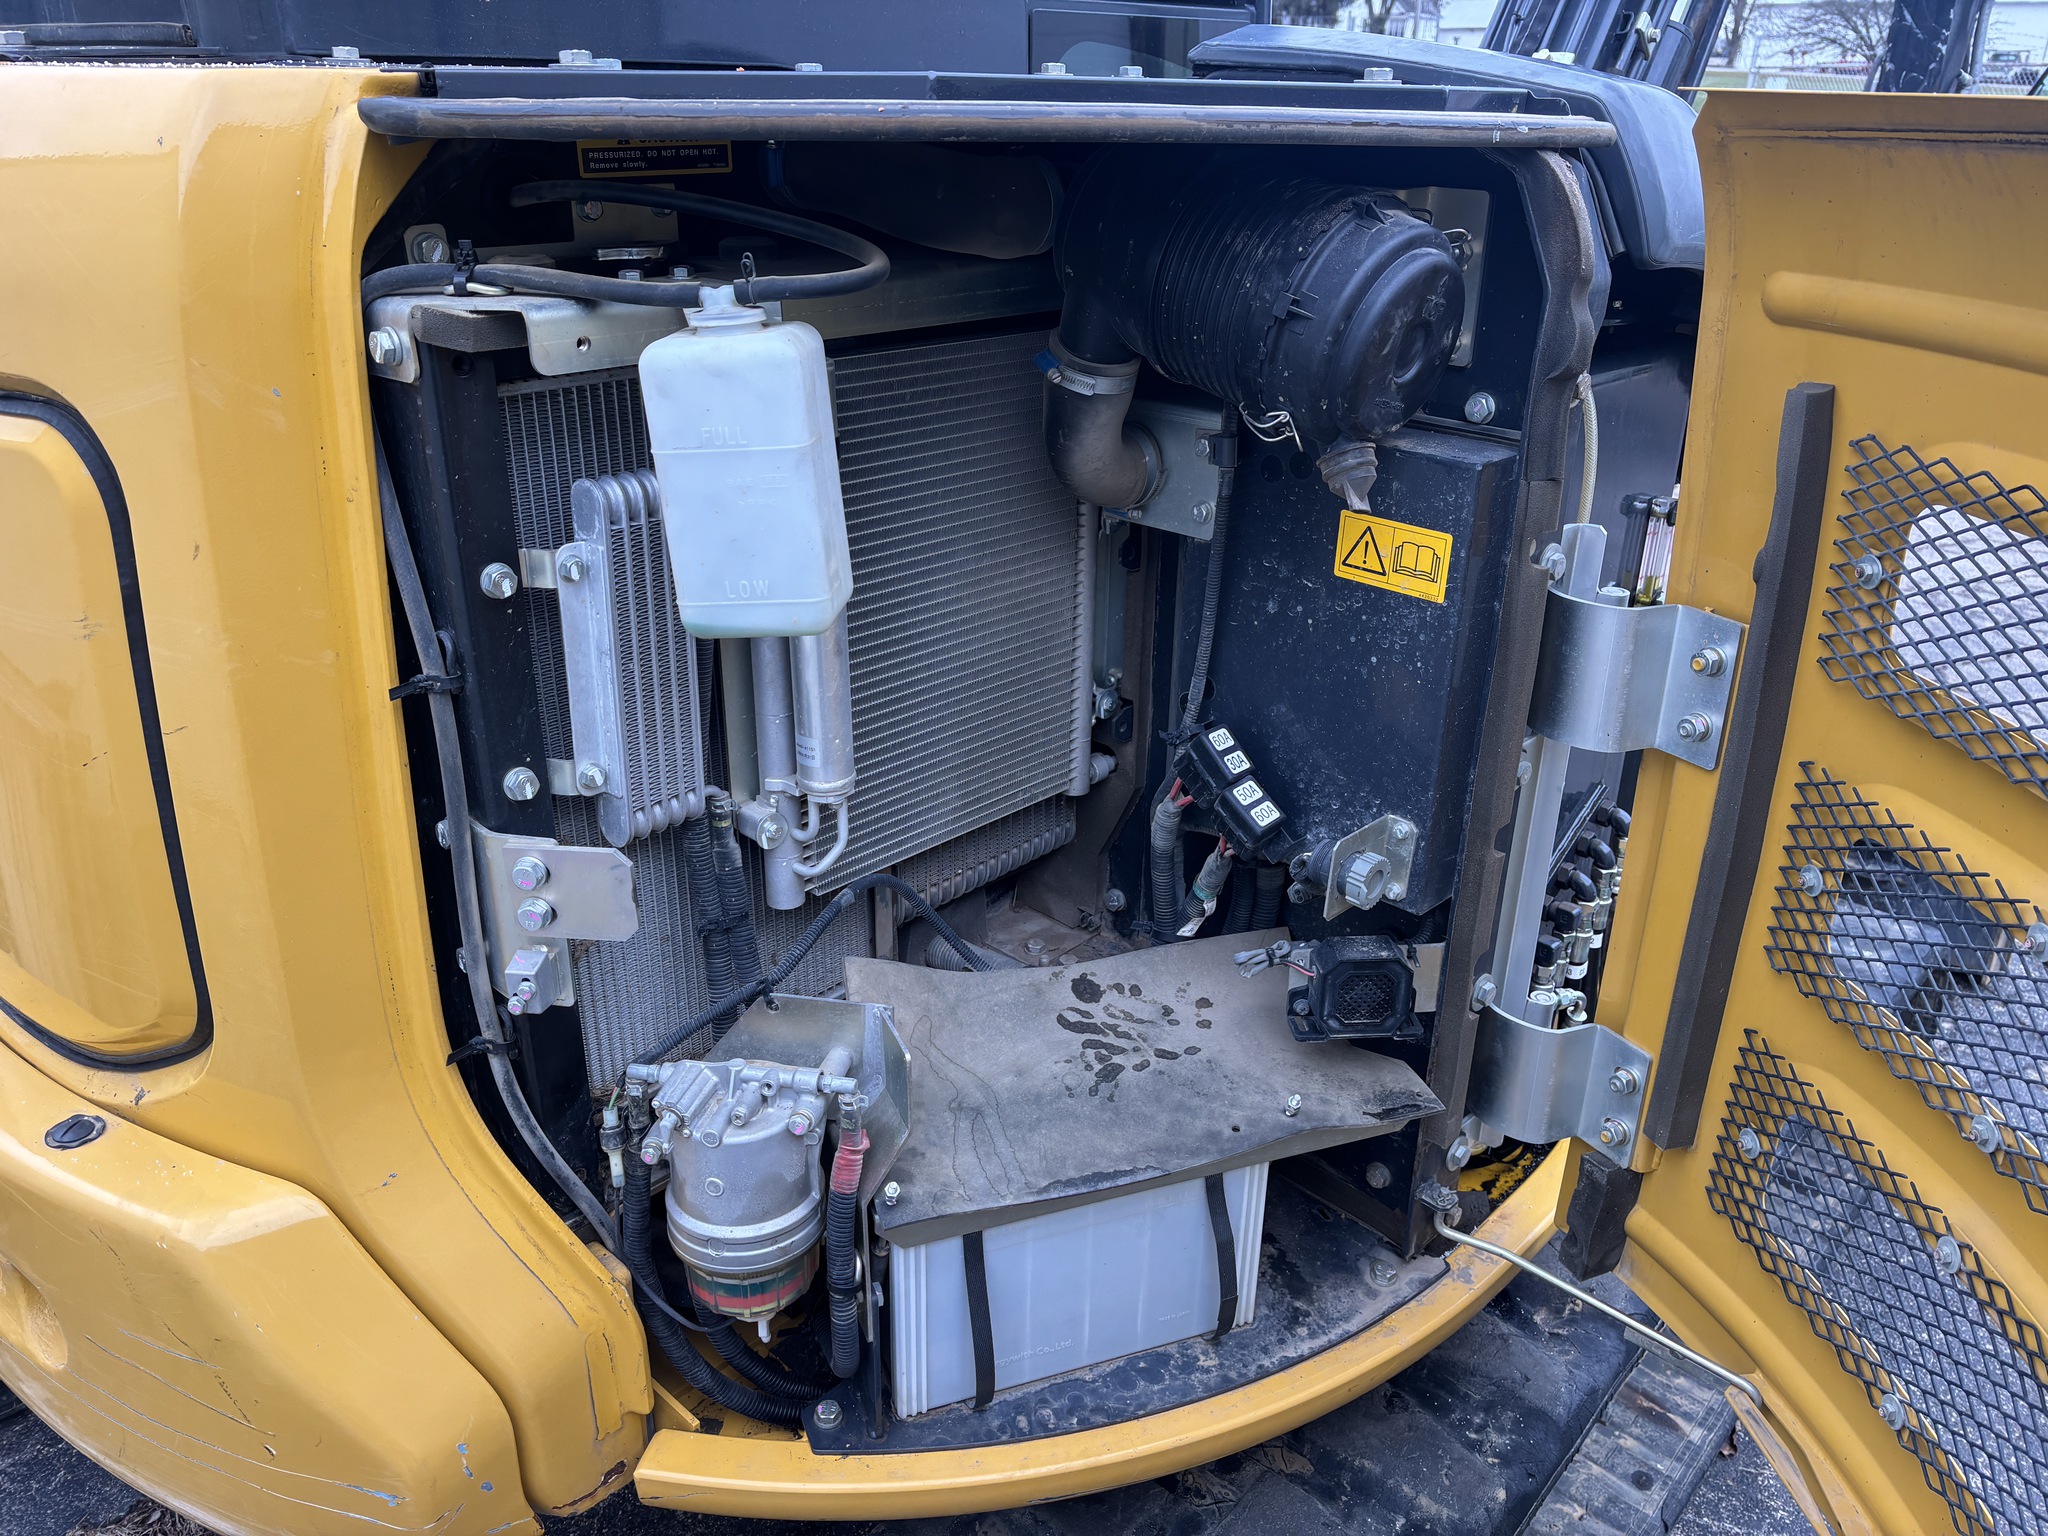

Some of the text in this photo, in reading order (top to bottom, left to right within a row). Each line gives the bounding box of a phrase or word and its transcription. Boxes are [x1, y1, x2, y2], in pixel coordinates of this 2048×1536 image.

[647, 150, 657, 158] DO
[661, 149, 676, 157] NOT
[680, 149, 699, 157] OPEN
[702, 148, 719, 156] HOT.
[589, 161, 648, 170] Remove slowly.
[701, 426, 748, 446] FULL
[725, 579, 770, 599] LOW
[1211, 731, 1233, 748] 60A
[1226, 754, 1248, 771] 30A
[1237, 783, 1260, 802] 50A
[1254, 804, 1277, 822] 60A
